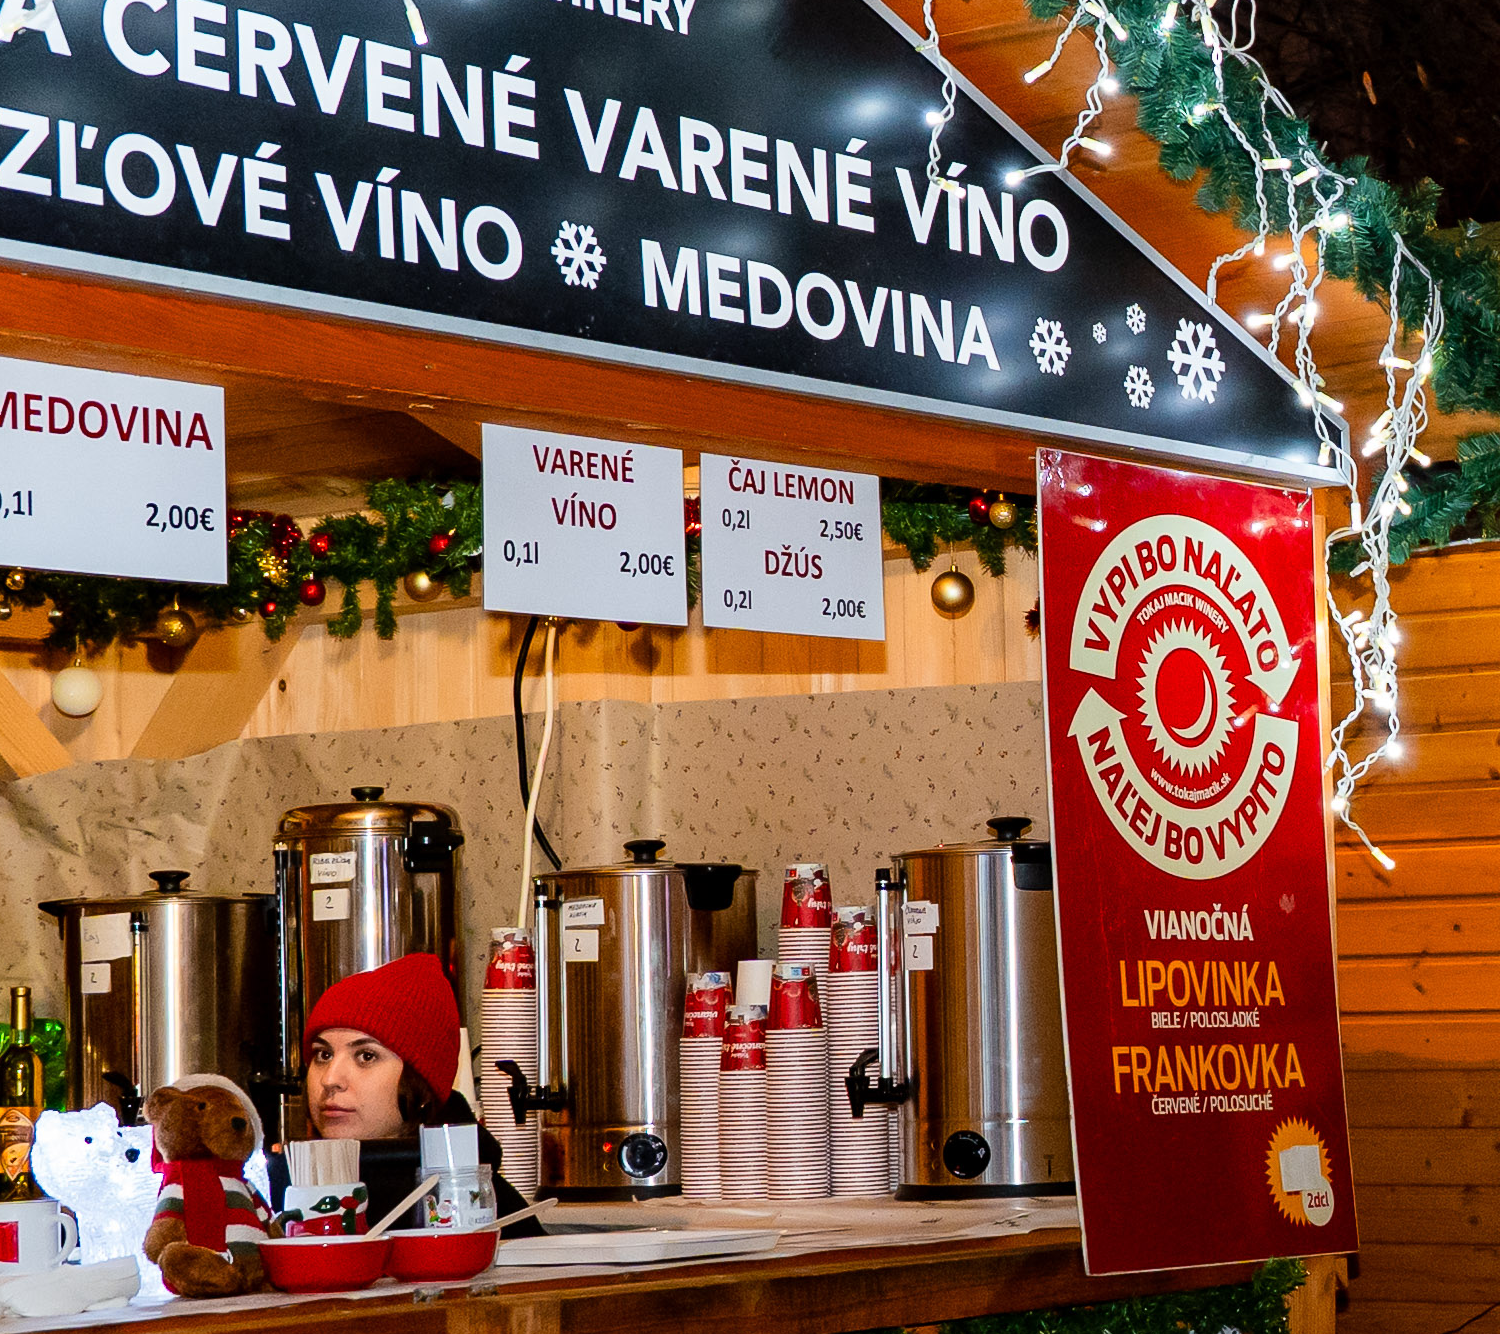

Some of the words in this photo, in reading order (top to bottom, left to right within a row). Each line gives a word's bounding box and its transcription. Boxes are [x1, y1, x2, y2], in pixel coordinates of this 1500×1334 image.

[563, 87, 876, 234] VARENÉ
[896, 163, 1071, 273] VÍNO
[315, 166, 524, 282] VÍNO
[640, 239, 1002, 372] MEDOVINA
[532, 444, 635, 484] VARENÉ
[728, 459, 766, 496] ČAJ
[773, 473, 855, 505] LEMON
[145, 501, 215, 534] 2,00€
[551, 492, 617, 531] VÍNO
[819, 519, 864, 542] 2,50€
[619, 551, 674, 578] 2,00€
[764, 543, 823, 581] DŽÚS
[821, 597, 866, 620] 2,00€
[1083, 554, 1140, 653] VYPI
[1138, 533, 1178, 581] BO
[1136, 593, 1166, 626] TOKAJ
[1163, 591, 1194, 609] MACIK
[1195, 597, 1229, 634] WINERY
[1087, 725, 1161, 848] NAĽEJ
[1164, 828, 1202, 865] BO
[1204, 741, 1286, 862] VYPITO
[1150, 766, 1232, 803] www.tokajmacik.sk
[325, 896, 333, 909] 2
[1144, 903, 1254, 941] VIANOČNÁ
[1119, 960, 1286, 1008] LIPOVINKA
[1151, 1012, 1182, 1029] BIELE
[1190, 1007, 1260, 1028] POLOSLADKÉ
[1111, 1043, 1306, 1094] FRANKOVKA
[1151, 1092, 1201, 1115] ČERVENÉ
[1210, 1089, 1274, 1113] POLOSUCHÉ
[1307, 1191, 1330, 1209] 2dcl
